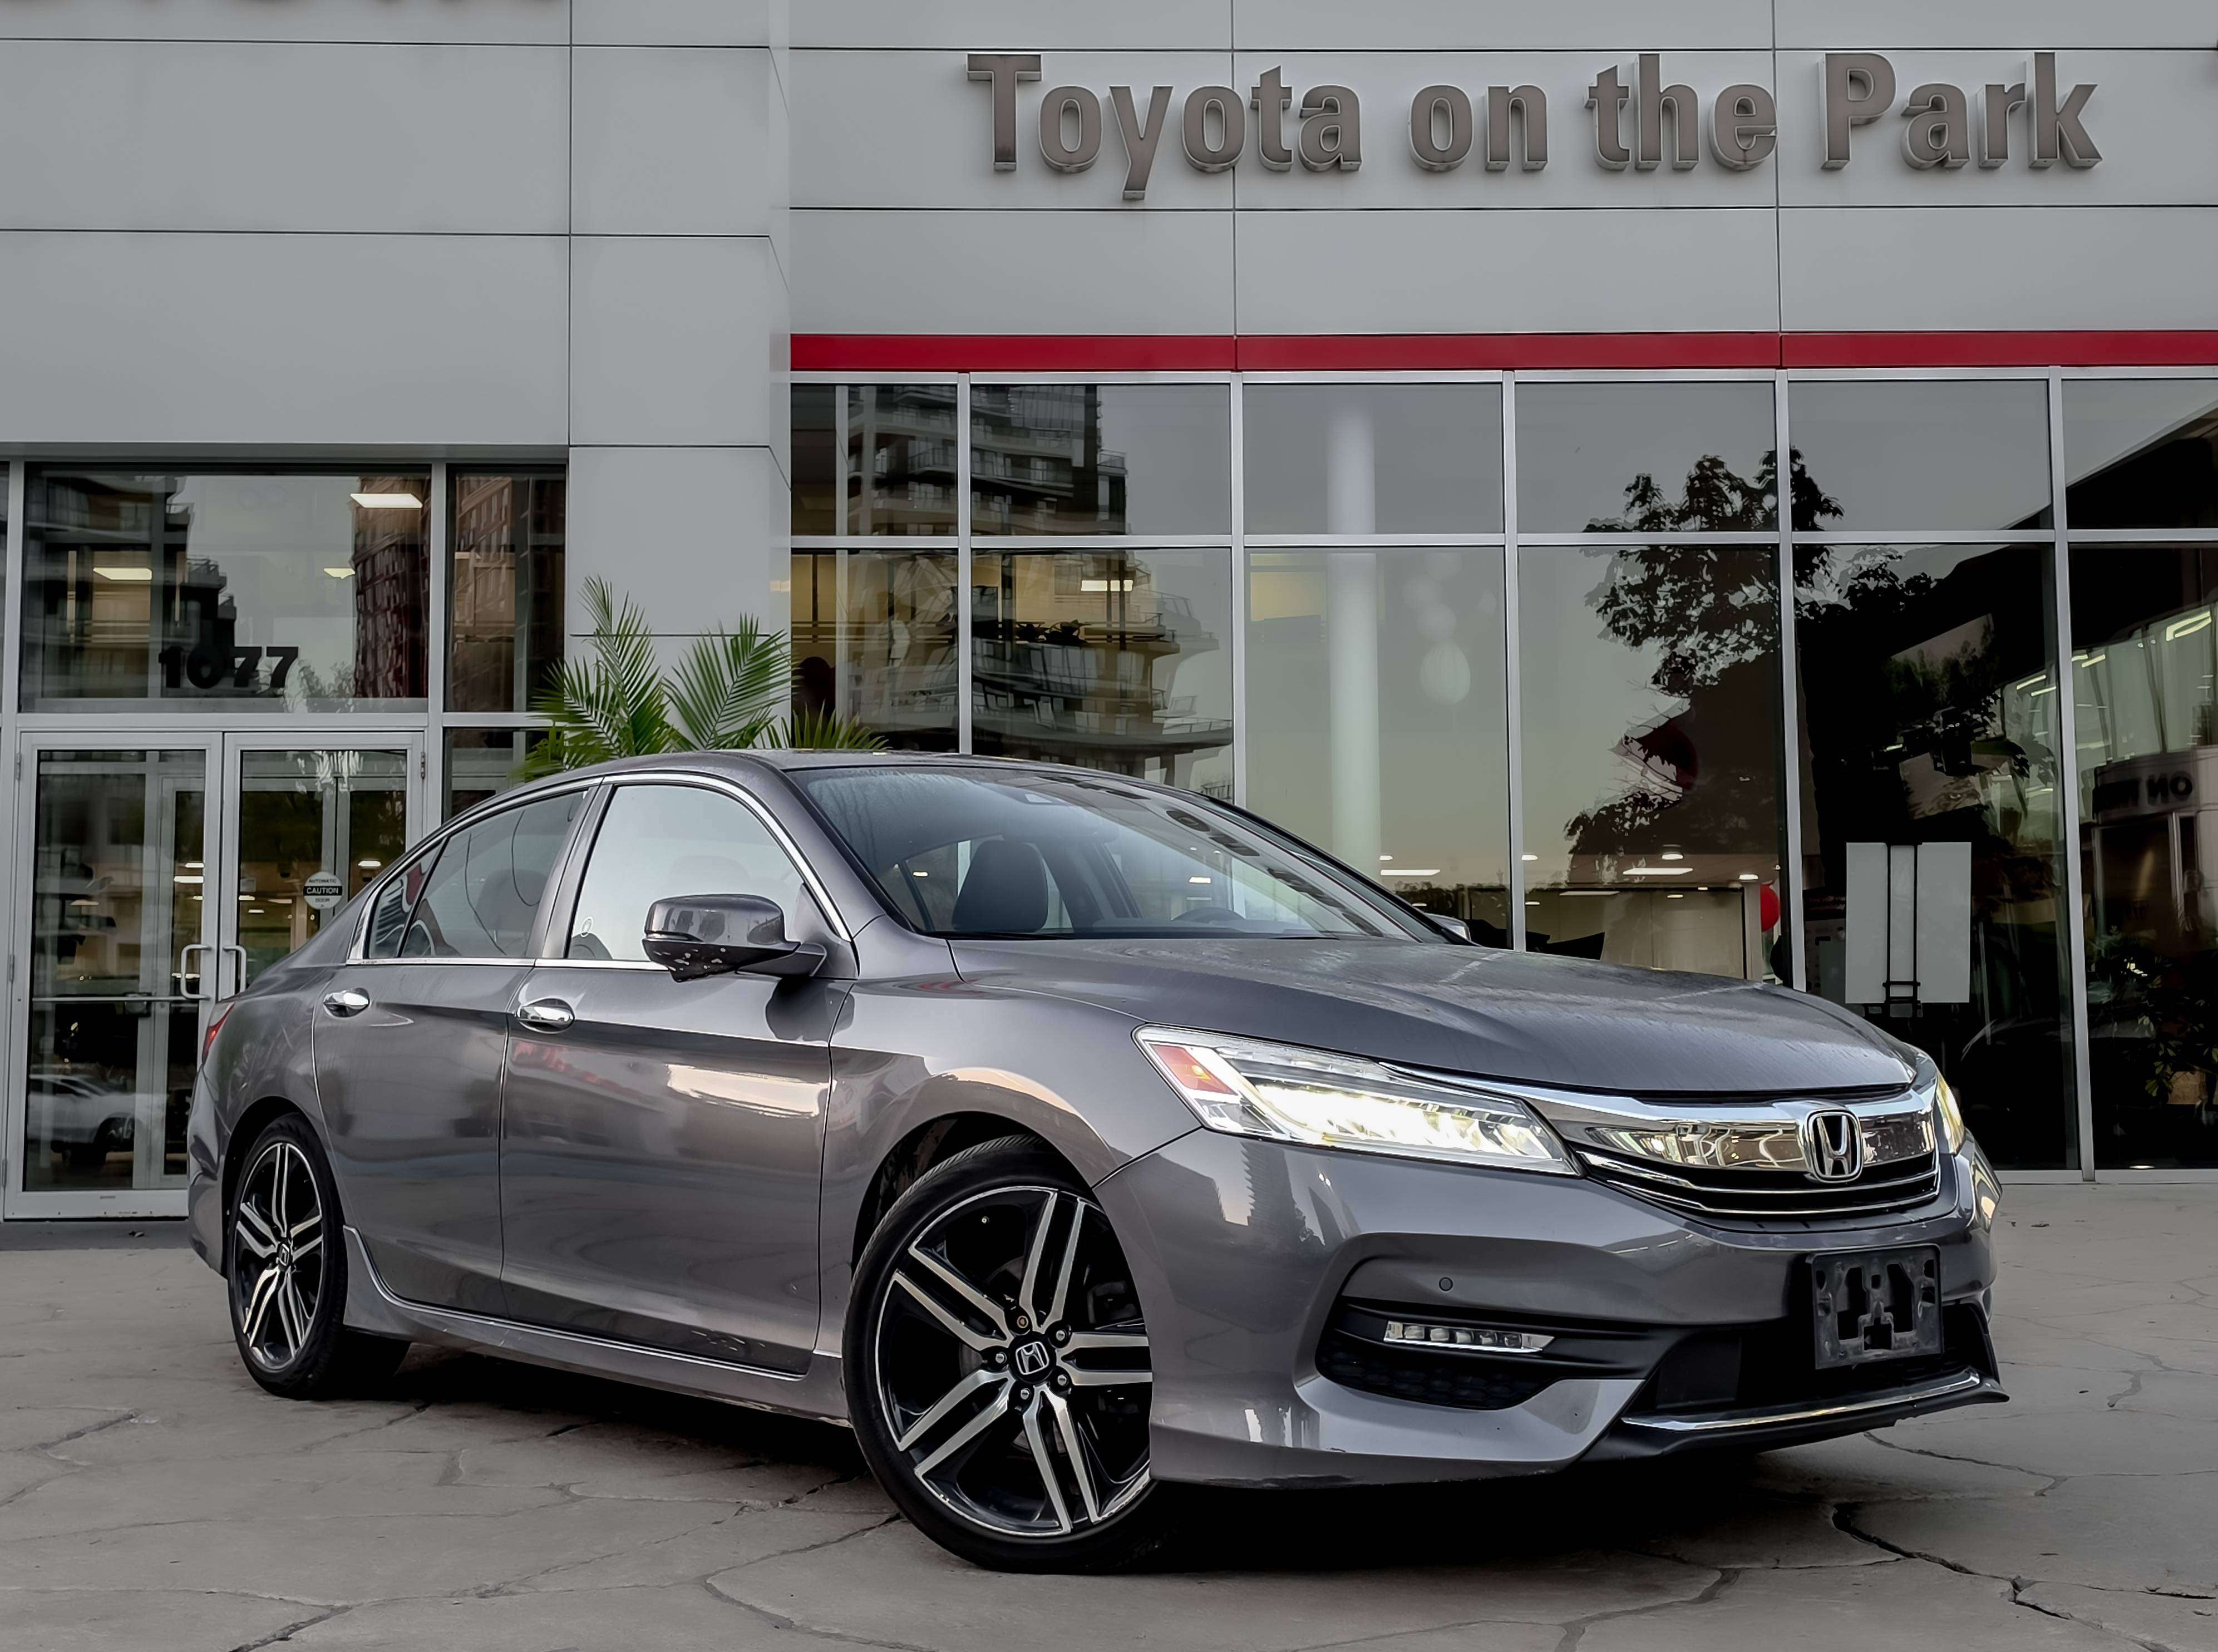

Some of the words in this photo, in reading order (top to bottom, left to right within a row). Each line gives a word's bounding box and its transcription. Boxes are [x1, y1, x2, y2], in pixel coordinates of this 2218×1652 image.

[966, 53, 1363, 200] Toyota
[1408, 83, 1549, 172] on
[1584, 52, 1779, 171] the
[1817, 52, 2103, 170] Park
[158, 645, 298, 689] 1077
[306, 887, 339, 895] CAUTION
